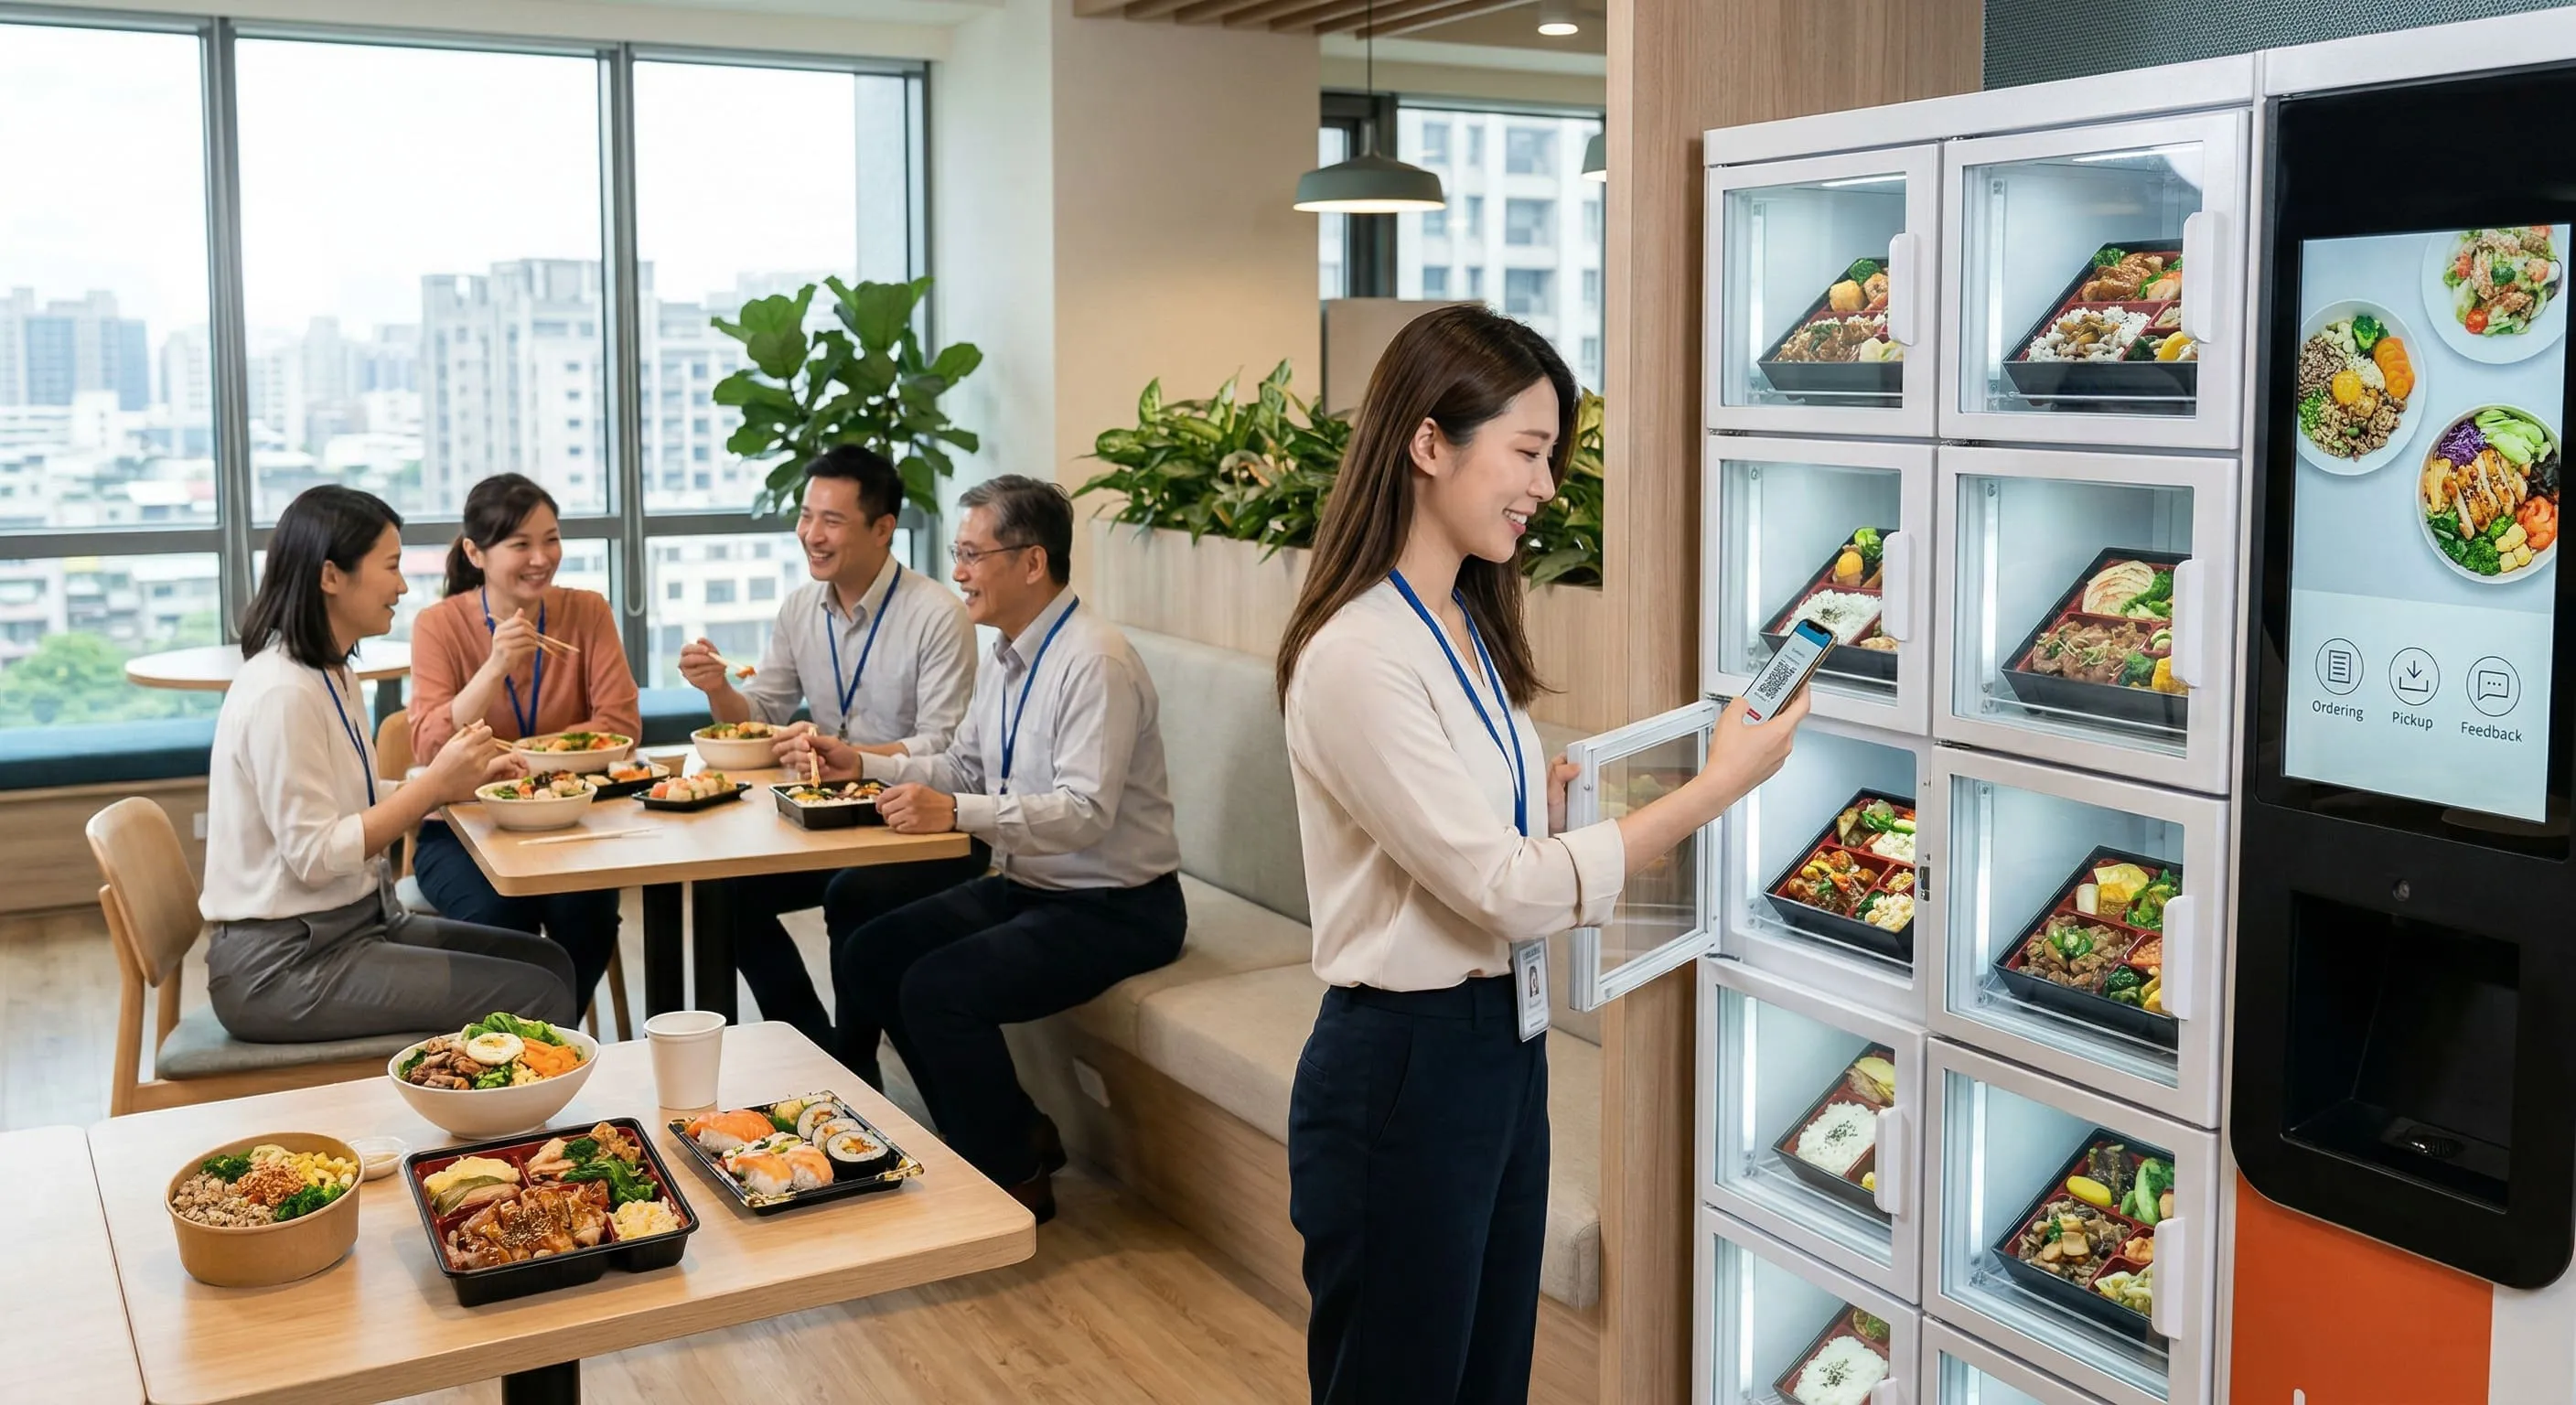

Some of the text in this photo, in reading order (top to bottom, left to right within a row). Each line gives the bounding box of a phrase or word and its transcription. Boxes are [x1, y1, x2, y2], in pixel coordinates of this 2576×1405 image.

[2312, 700, 2523, 743] Ordering Pickup Feedback
